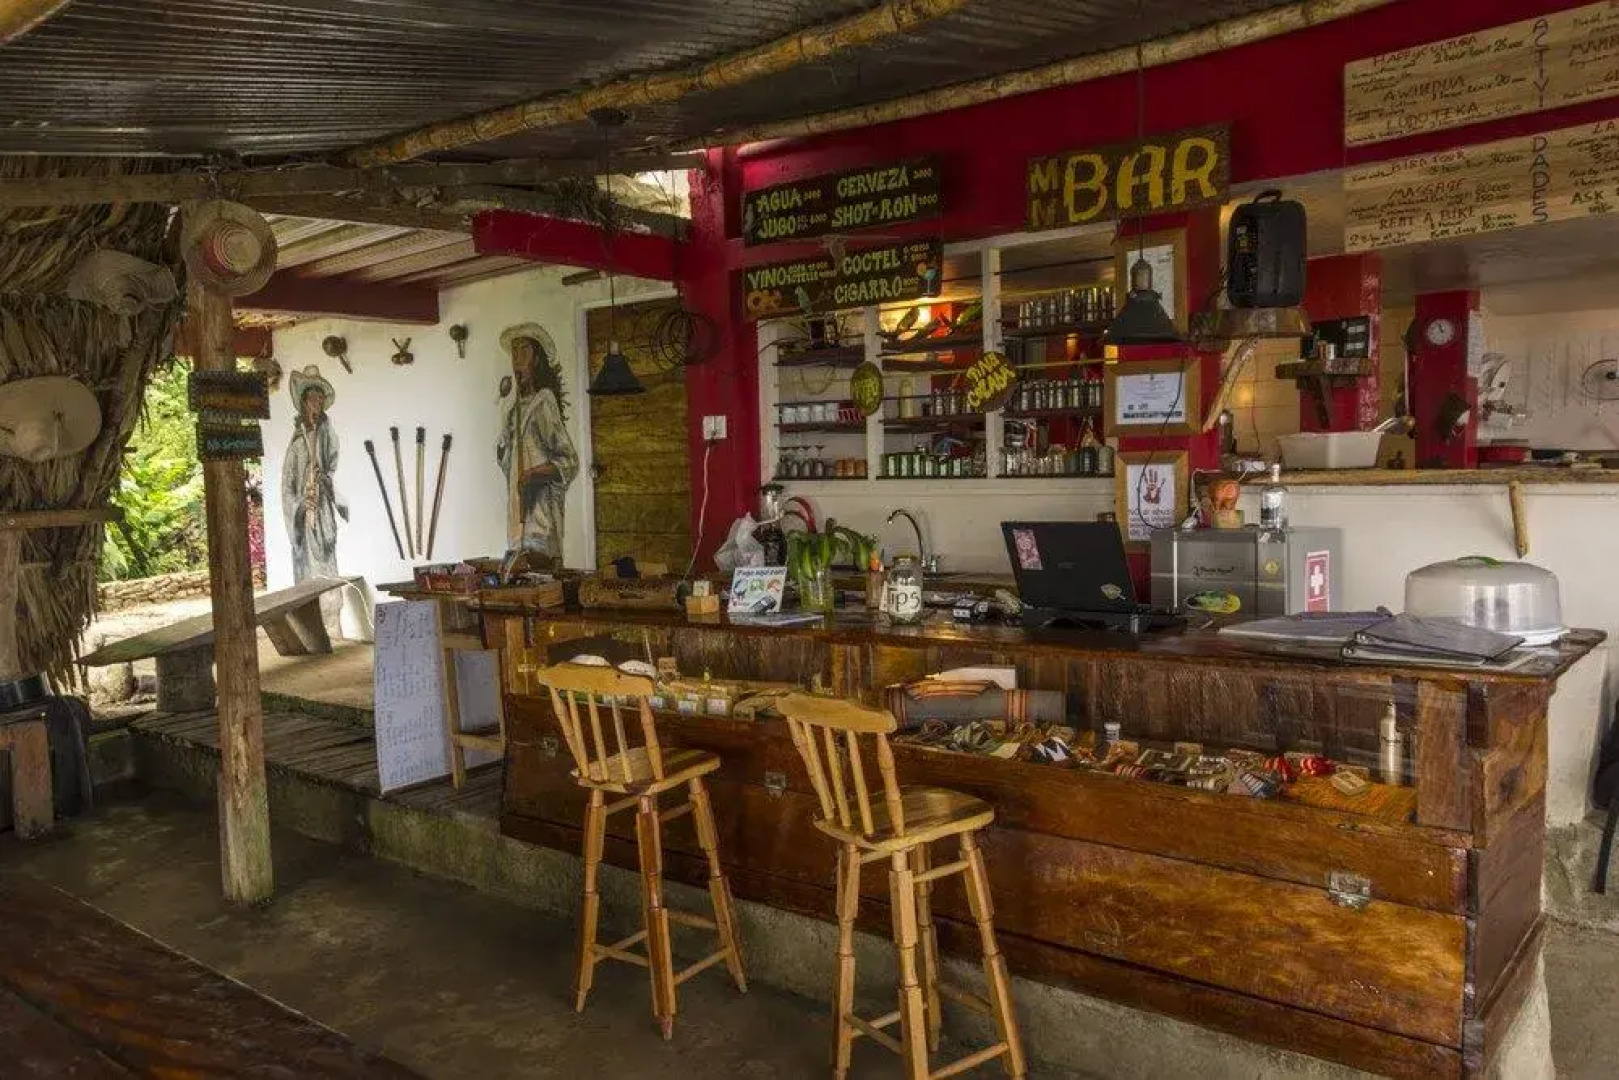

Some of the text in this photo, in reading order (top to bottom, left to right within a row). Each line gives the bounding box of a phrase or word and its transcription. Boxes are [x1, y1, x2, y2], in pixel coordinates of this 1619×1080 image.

[837, 165, 910, 197] CERVEZA
[1062, 137, 1219, 223] BAR
[756, 188, 803, 213] AGUA
[758, 216, 796, 239] JUGO
[841, 248, 901, 276] COCTEL
[748, 268, 787, 290] VINO
